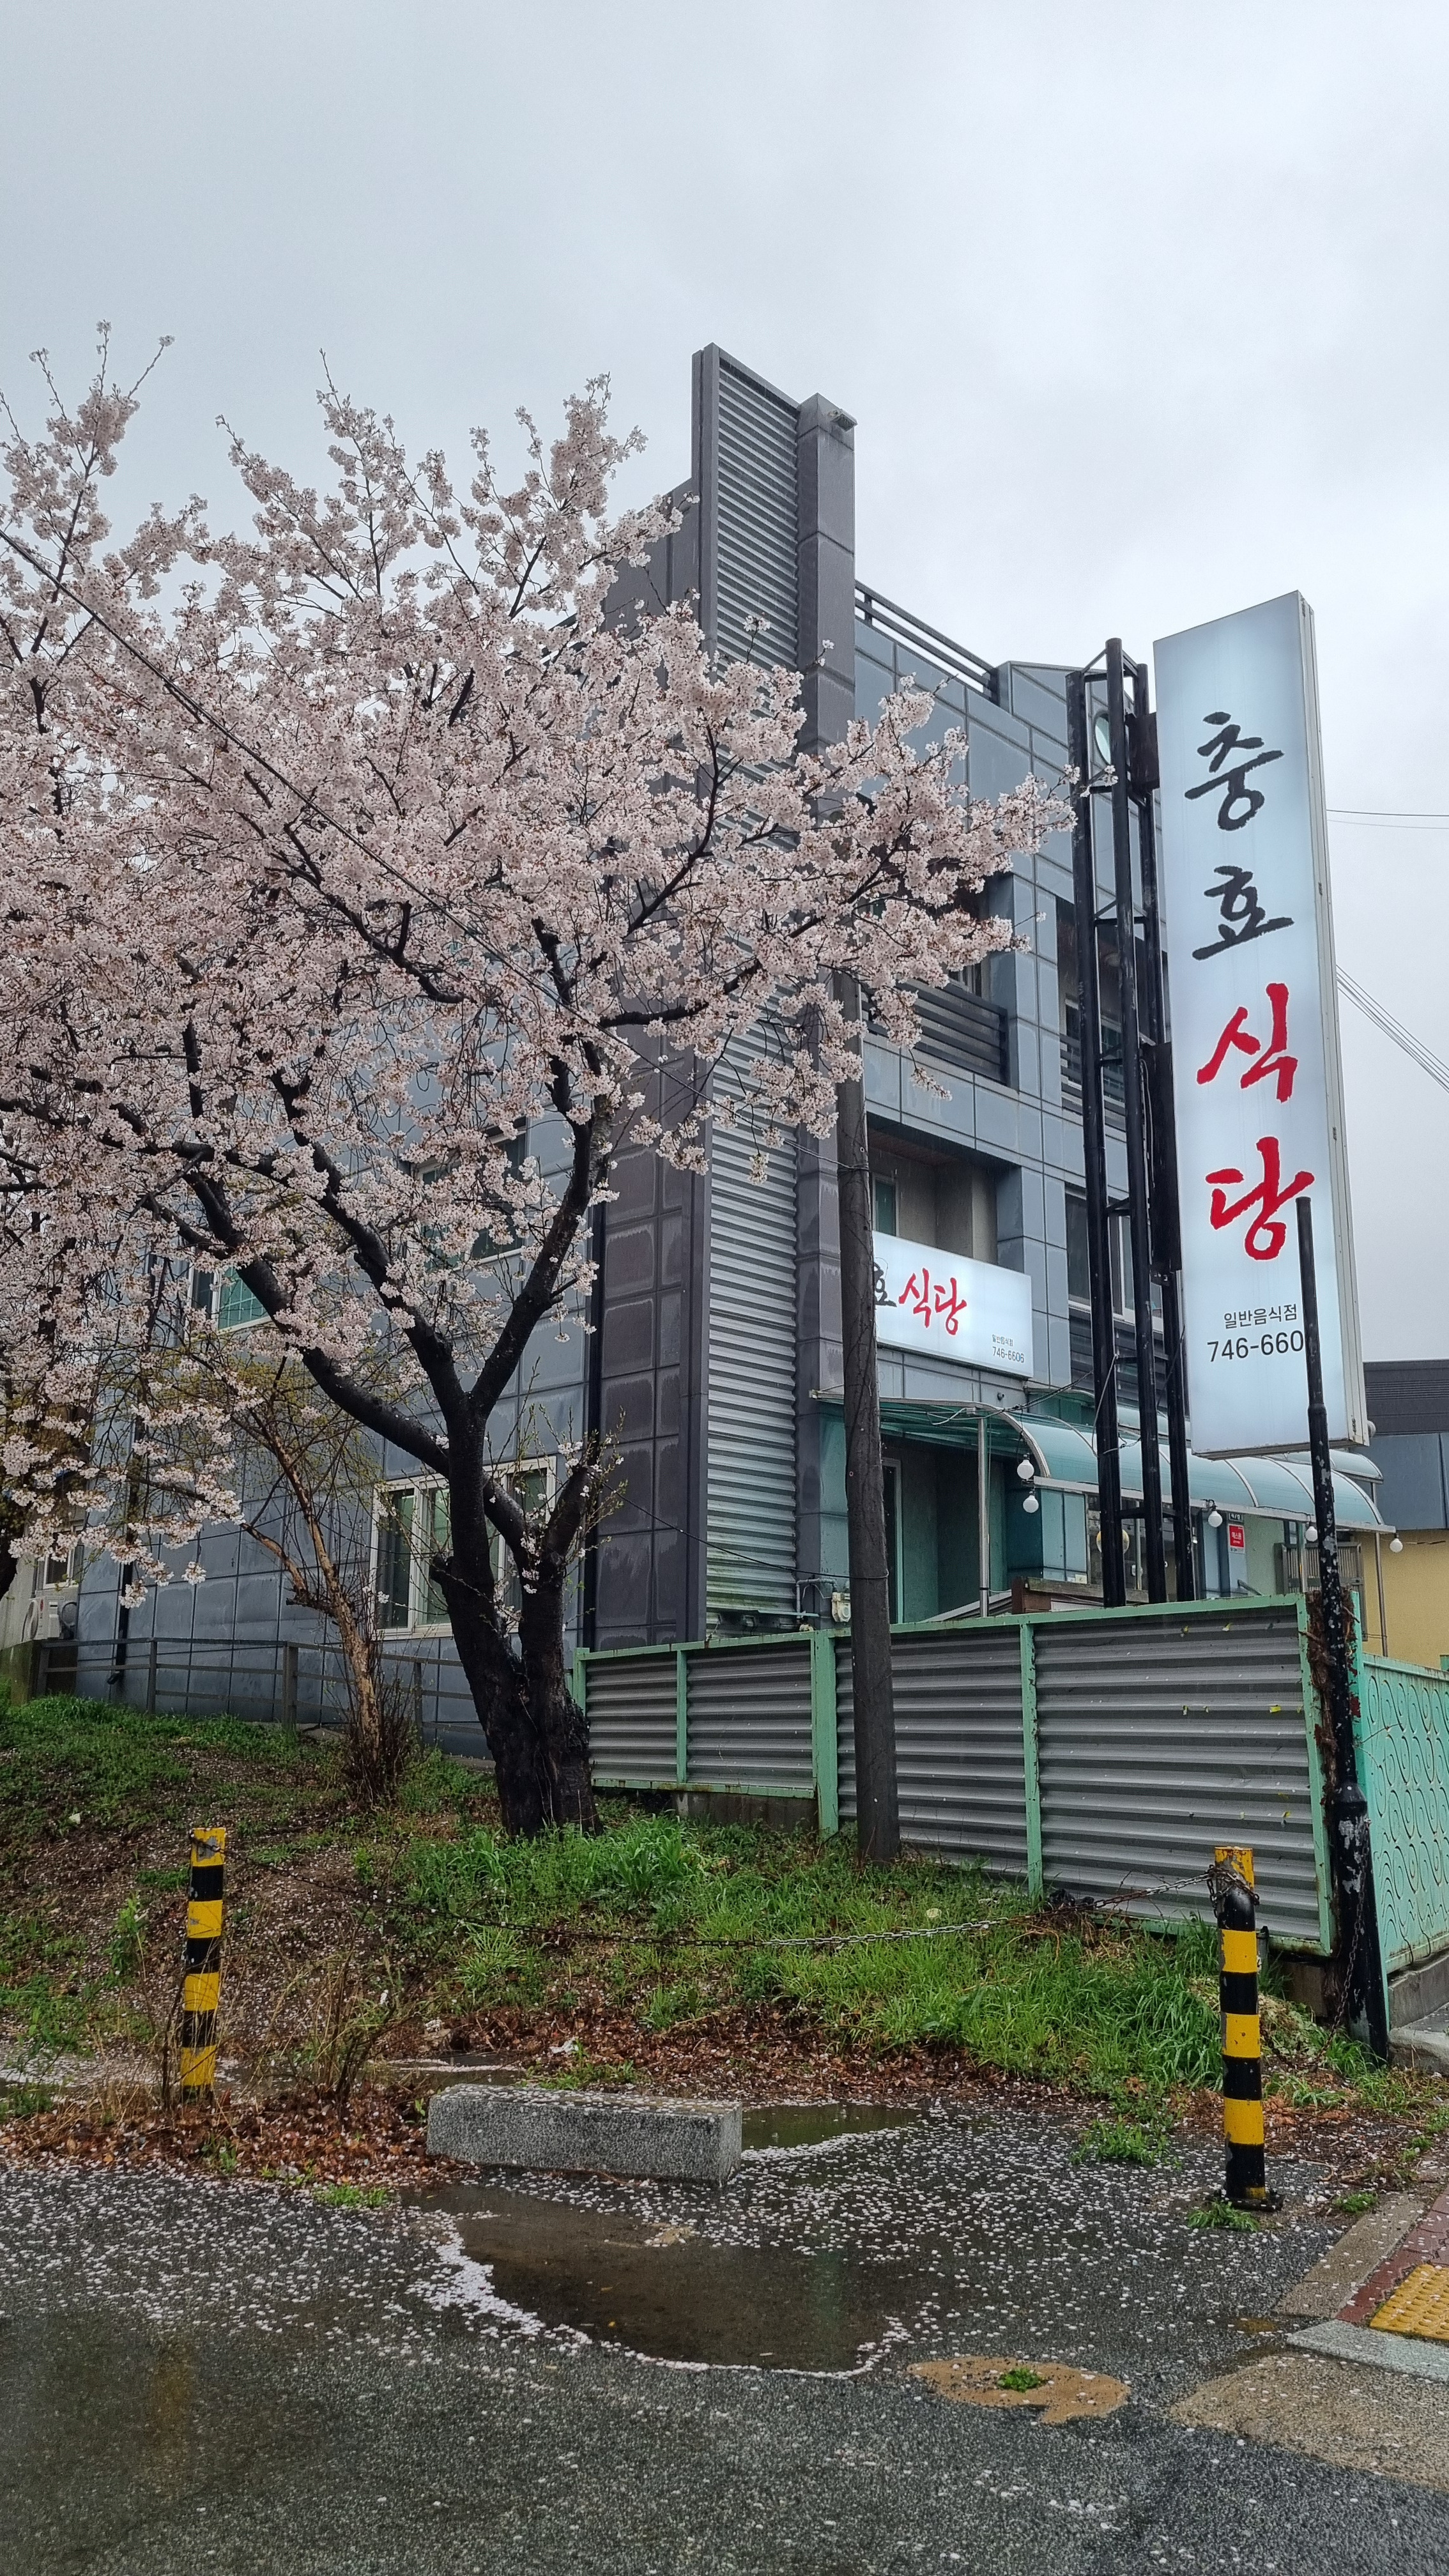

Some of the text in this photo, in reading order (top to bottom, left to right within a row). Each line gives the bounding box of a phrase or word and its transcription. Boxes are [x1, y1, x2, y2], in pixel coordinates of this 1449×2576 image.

[1223, 1303, 1297, 1330] 일반음식점
[992, 1346, 1025, 1363] 746-6606
[1207, 1330, 1304, 1362] 746-660
